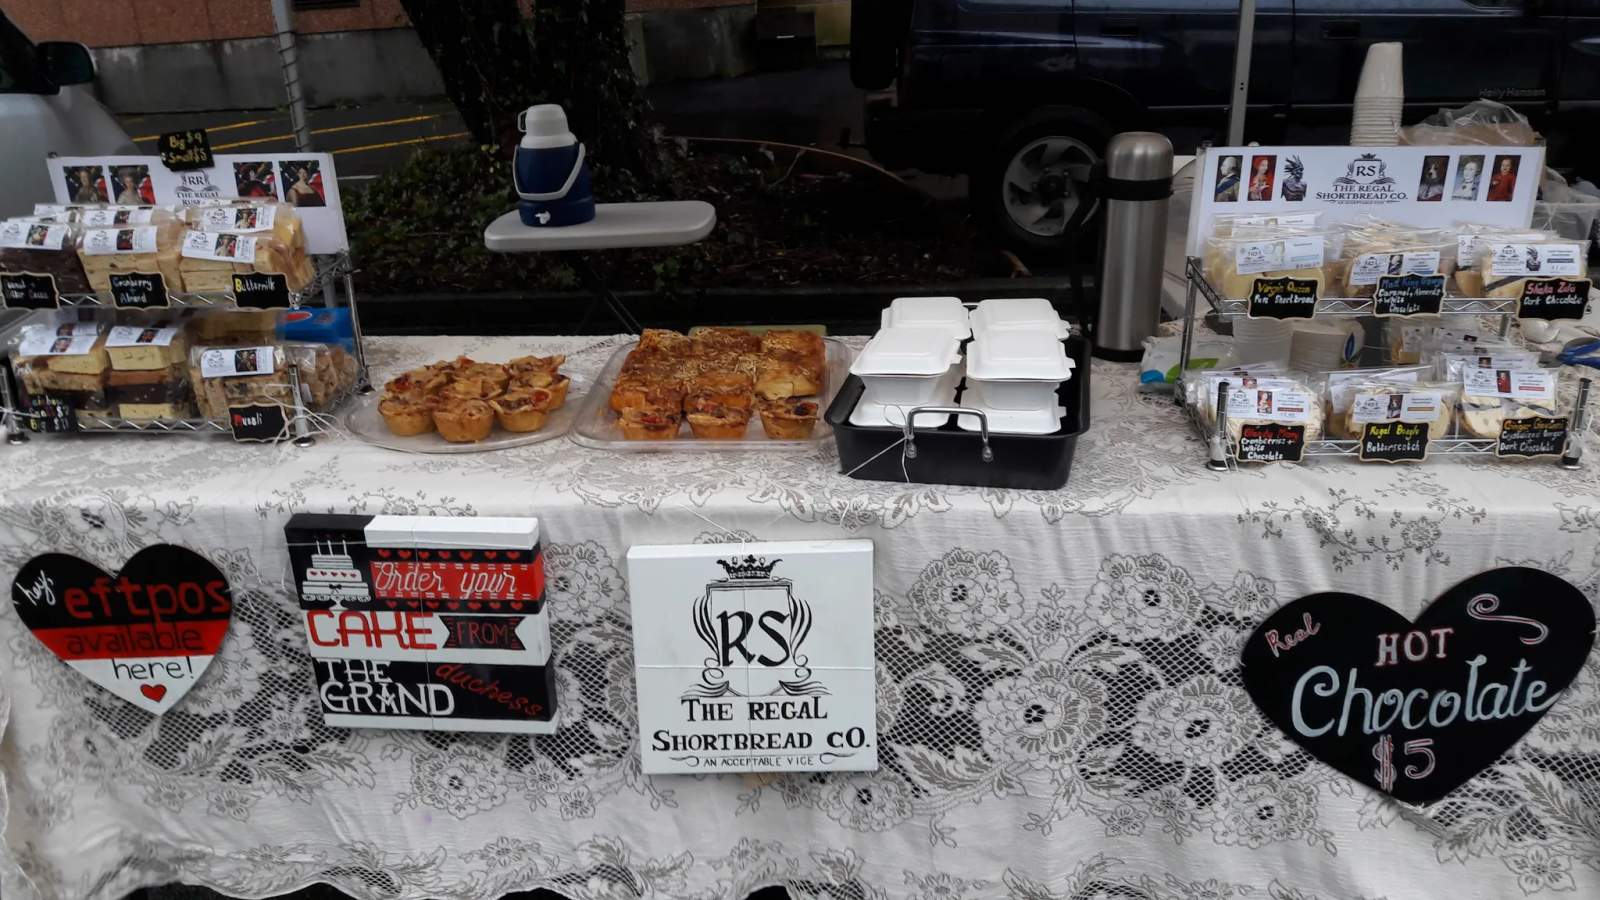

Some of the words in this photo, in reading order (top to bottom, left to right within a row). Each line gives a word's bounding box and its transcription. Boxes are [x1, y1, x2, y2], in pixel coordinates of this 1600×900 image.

[188, 176, 205, 185] RR
[1356, 165, 1376, 176] RS
[176, 191, 192, 199] THE
[1315, 191, 1388, 200] SHORTBREAD
[1389, 191, 1408, 200] CO.
[1332, 184, 1356, 192] THE
[1358, 184, 1394, 192] REGAL
[375, 562, 444, 592] Order
[460, 571, 517, 600] your
[64, 576, 231, 625] eftpos
[65, 622, 203, 656] available
[306, 610, 437, 650] CAKE
[456, 620, 511, 646] FROM
[716, 609, 791, 667] RS
[1265, 612, 1322, 658] Real
[1374, 627, 1455, 667] HOT
[112, 655, 194, 680] here!
[316, 658, 393, 683] THE
[320, 681, 456, 716] GRAND
[435, 662, 543, 716] duchess
[1291, 654, 1563, 738] Chocolate
[680, 697, 734, 722] THE
[747, 695, 828, 721] REGAL
[651, 728, 813, 752] SHORTBREAD
[703, 757, 717, 767] AN
[720, 756, 782, 767] ACCEPTABLE
[787, 756, 814, 766] VICE
[1371, 734, 1436, 793] $5
